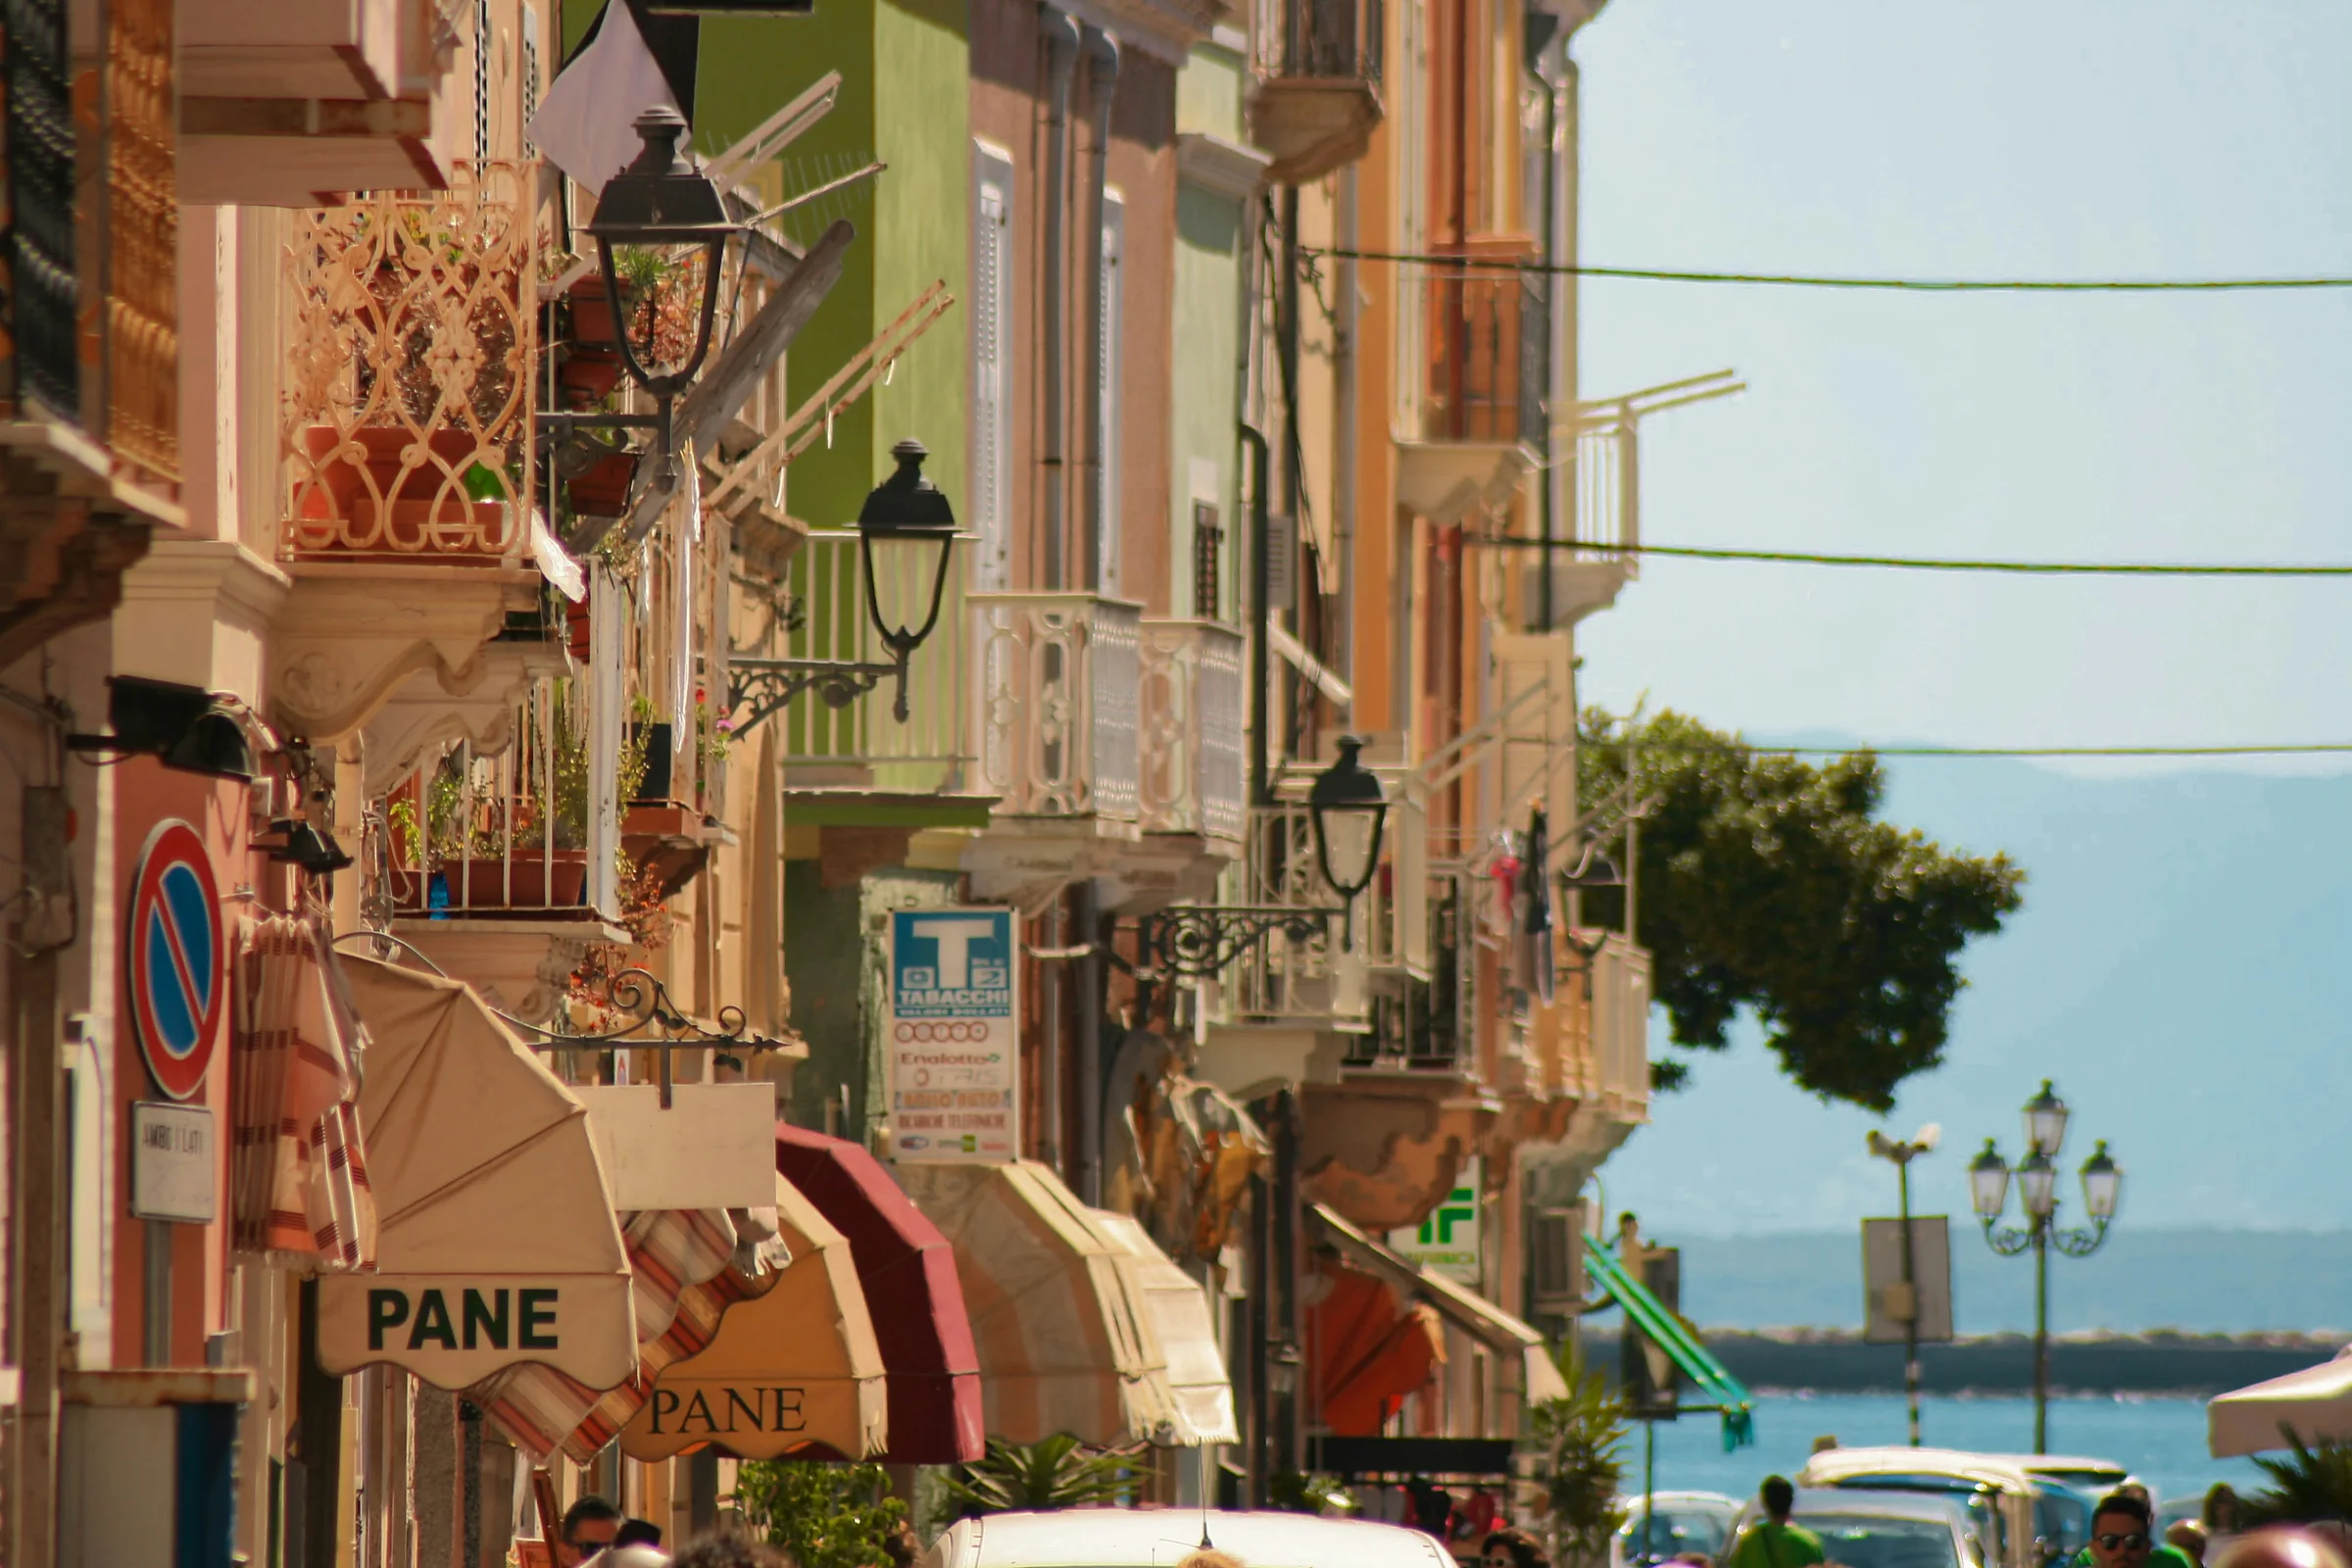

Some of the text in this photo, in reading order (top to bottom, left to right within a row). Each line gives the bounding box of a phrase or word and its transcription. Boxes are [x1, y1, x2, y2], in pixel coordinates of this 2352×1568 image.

[912, 919, 995, 989] T
[899, 990, 1008, 1005] TABACCHI
[901, 1053, 988, 1065] Enalotto
[368, 1289, 559, 1349] PANE
[648, 1388, 807, 1434] PANE
